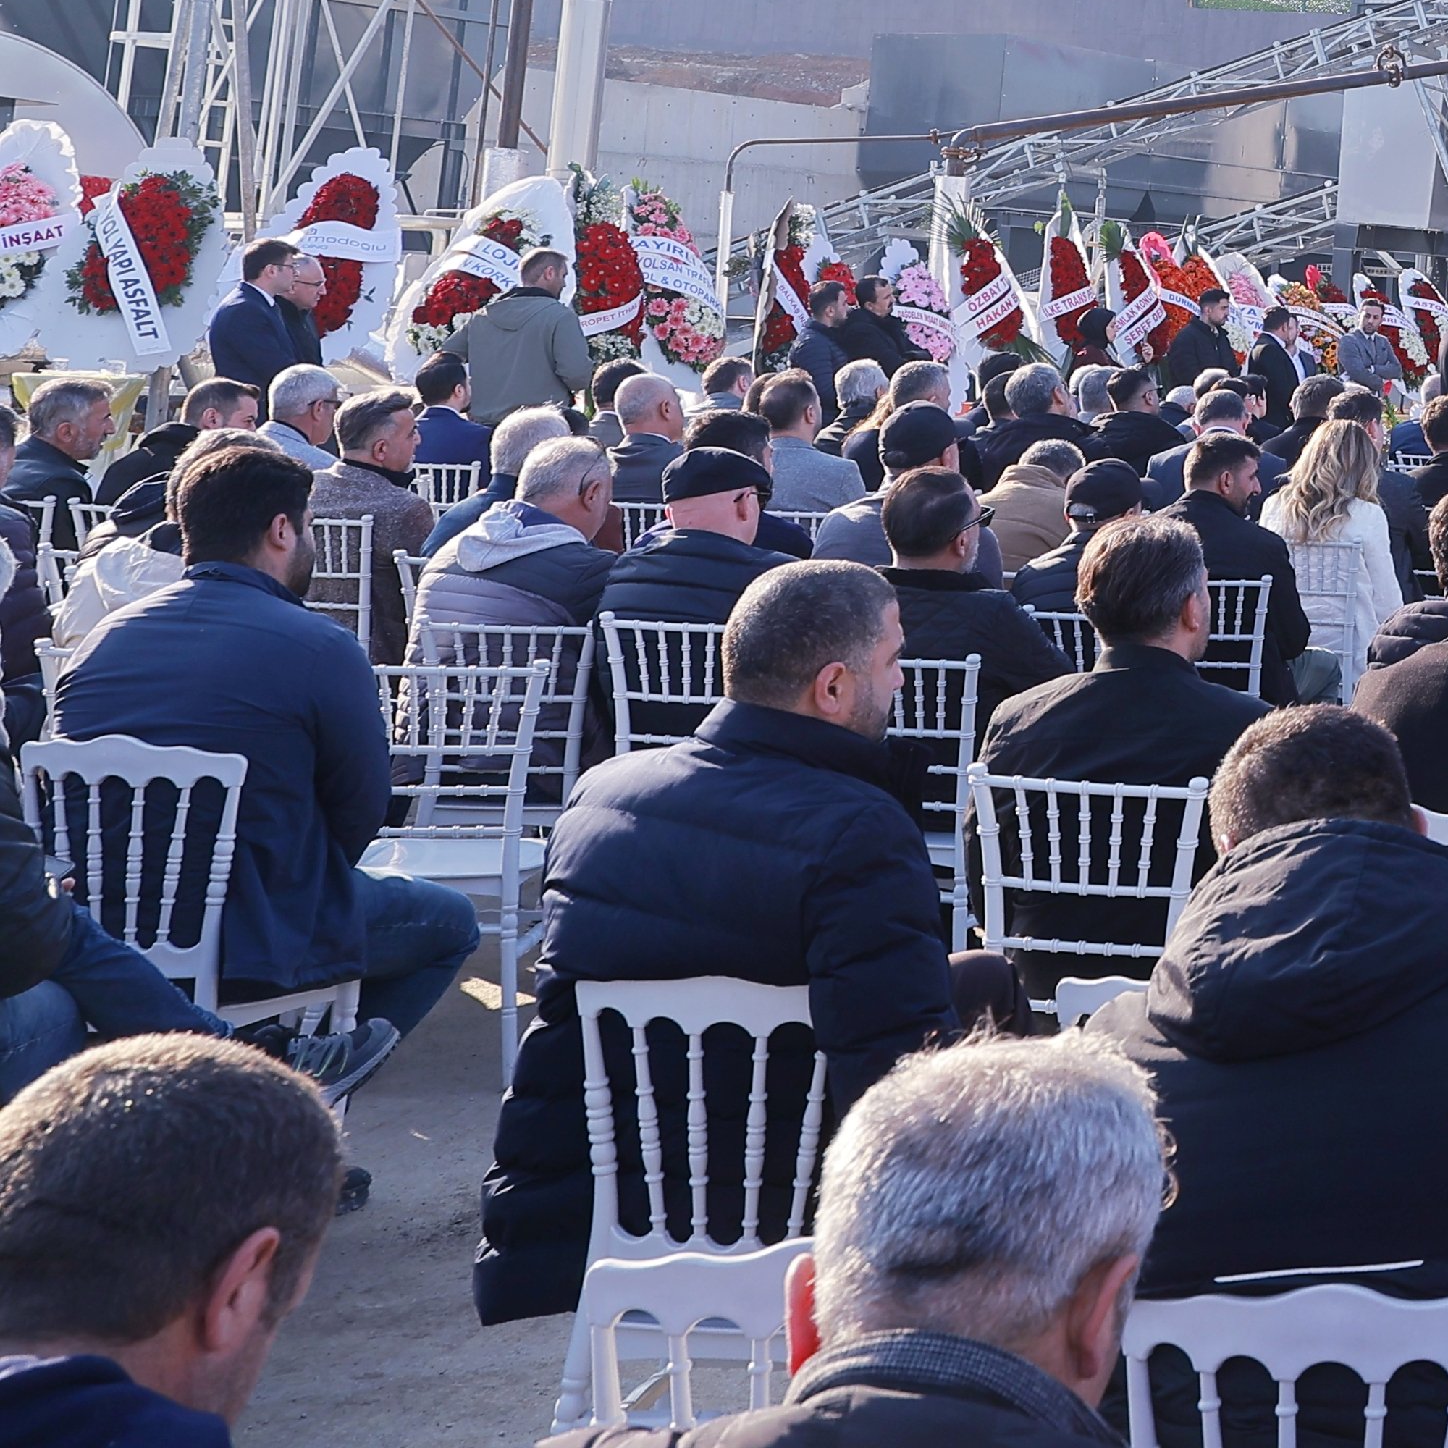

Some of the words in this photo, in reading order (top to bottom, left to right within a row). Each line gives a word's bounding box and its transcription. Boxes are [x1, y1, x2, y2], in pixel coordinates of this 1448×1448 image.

[1, 225, 63, 249] İNŞAAT
[119, 278, 159, 339] ASFALT
[976, 301, 1013, 330] HAKAN
